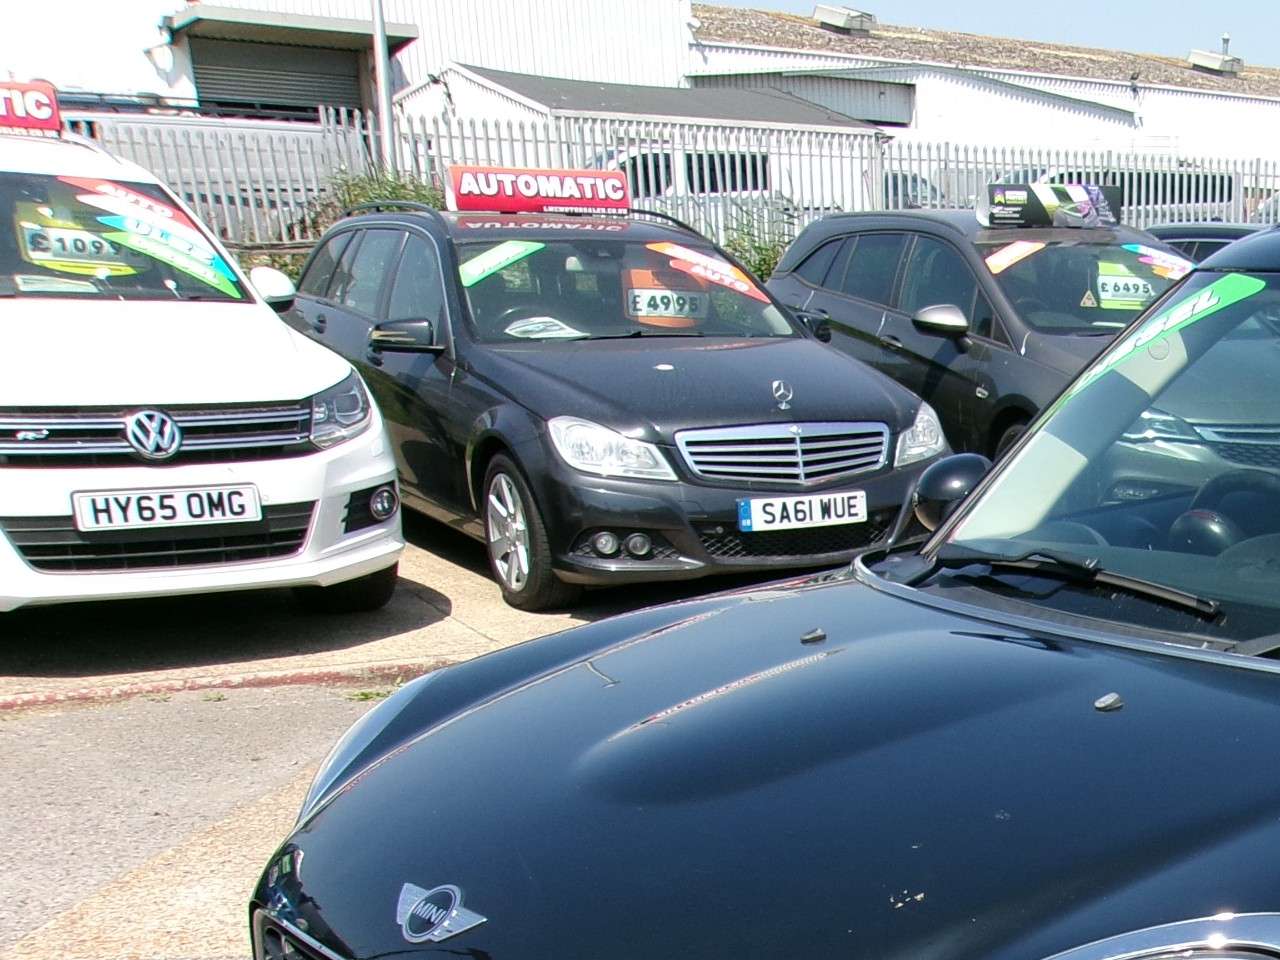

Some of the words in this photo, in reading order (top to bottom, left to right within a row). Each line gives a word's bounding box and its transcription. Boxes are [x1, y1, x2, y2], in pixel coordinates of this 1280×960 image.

[460, 172, 625, 200] AUTOMATIC
[1101, 282, 1150, 294] £6495
[91, 494, 177, 524] HY65
[186, 491, 246, 519] OMG
[762, 499, 813, 525] SA61
[820, 495, 859, 520] WUE
[412, 900, 448, 925] MINI
